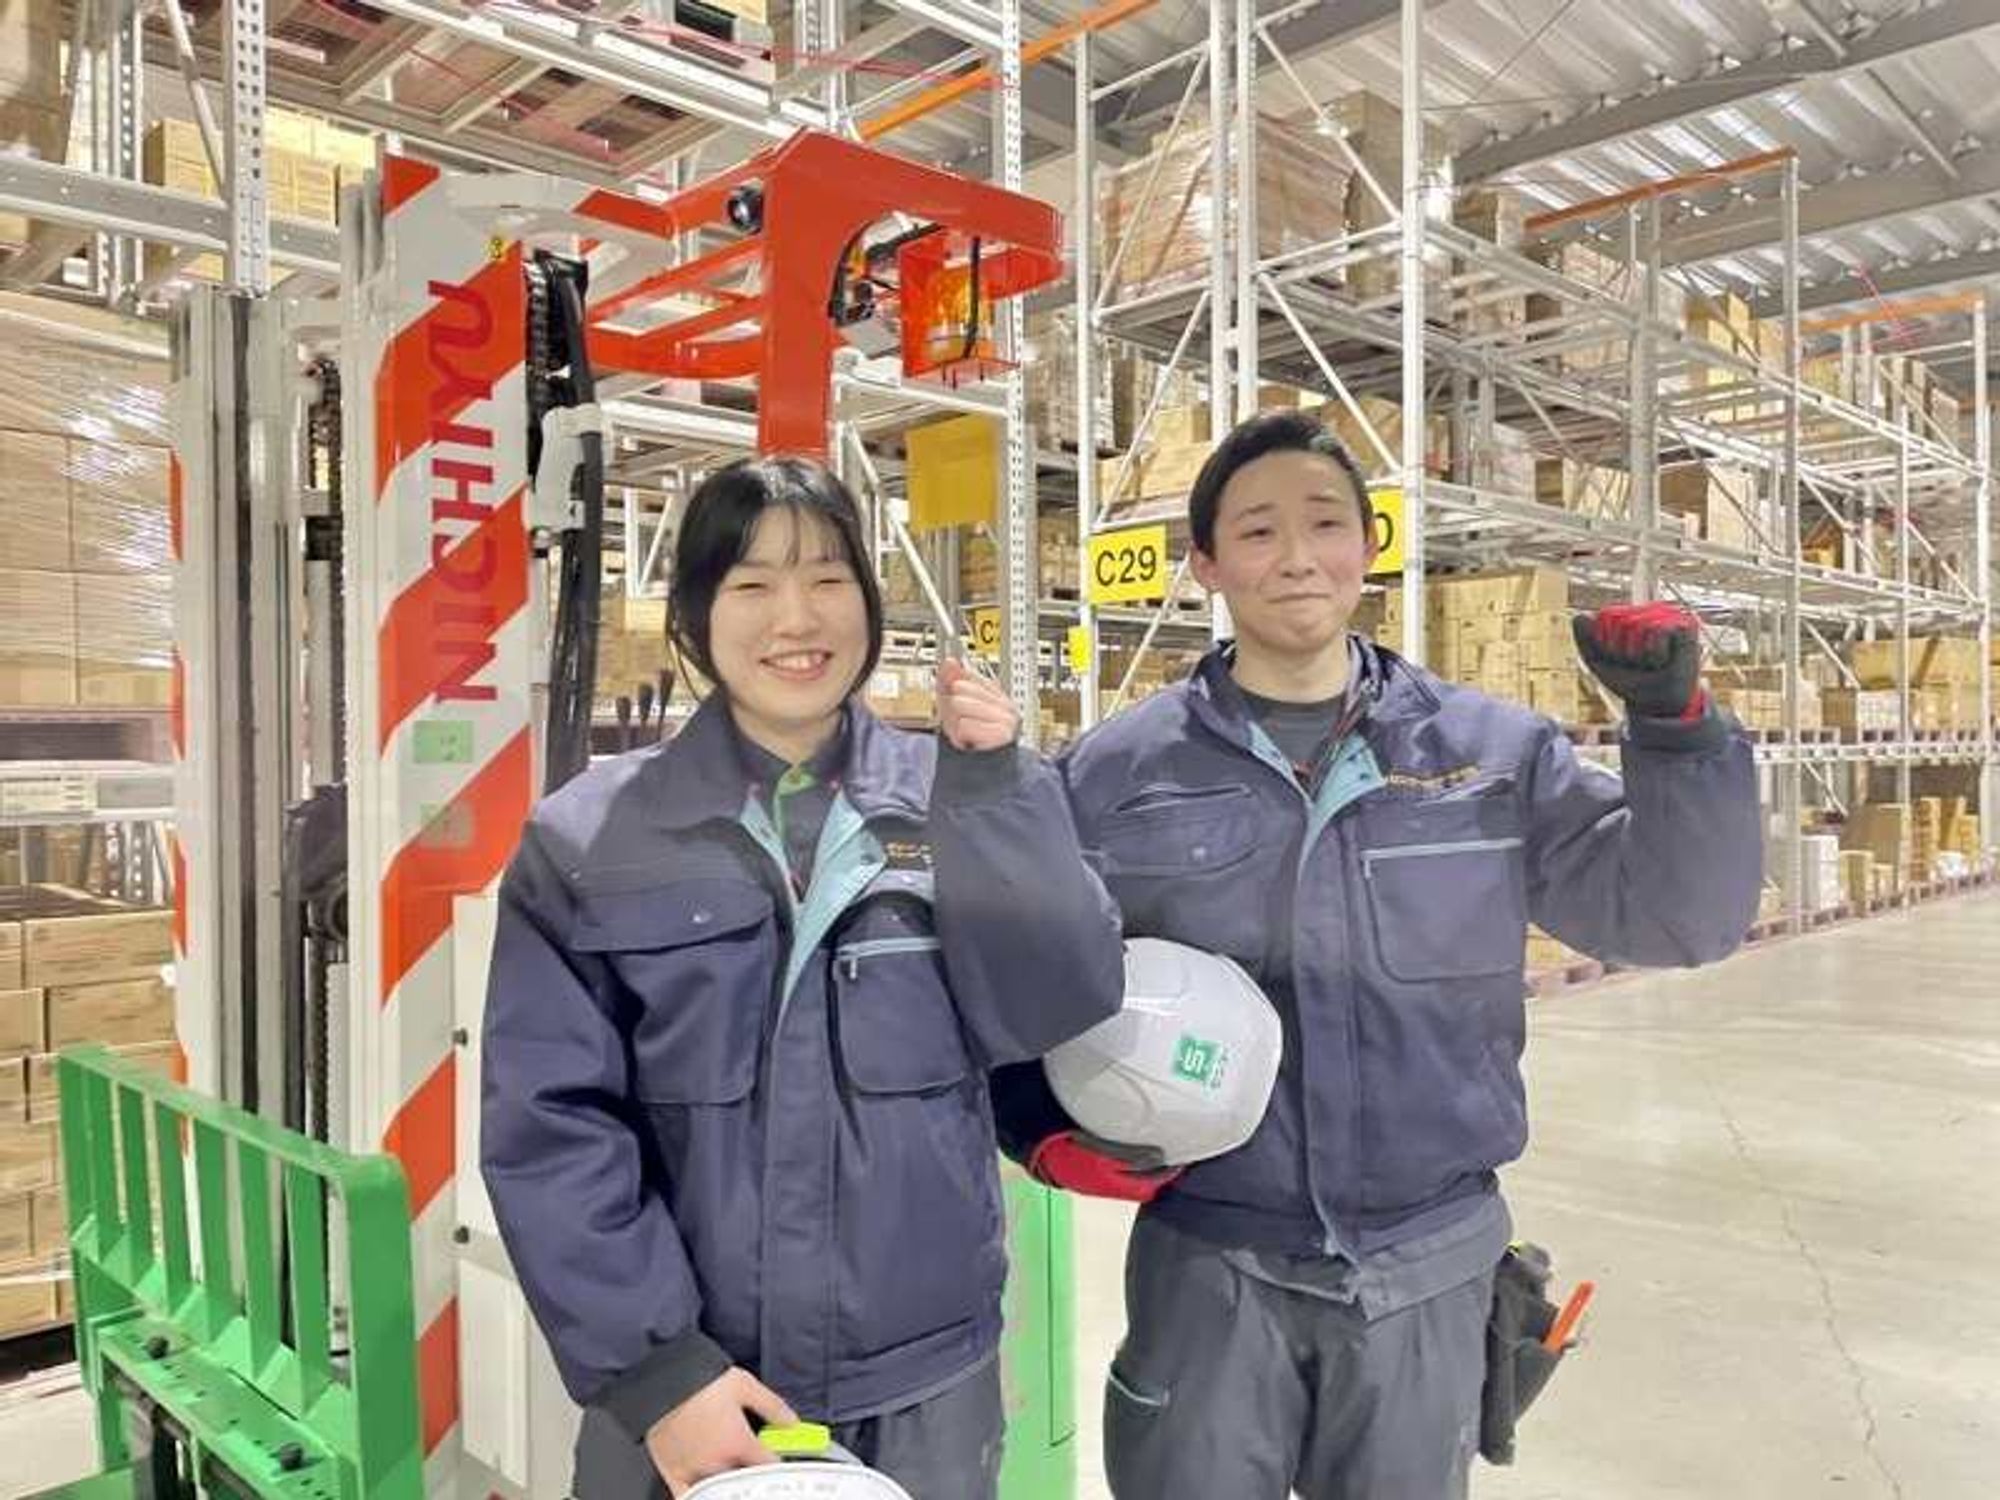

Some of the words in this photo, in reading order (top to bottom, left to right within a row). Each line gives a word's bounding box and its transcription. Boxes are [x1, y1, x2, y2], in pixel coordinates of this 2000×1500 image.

[428, 280, 498, 702] NICHIYU
[1096, 545, 1156, 587] C29
[980, 620, 1000, 644] C
